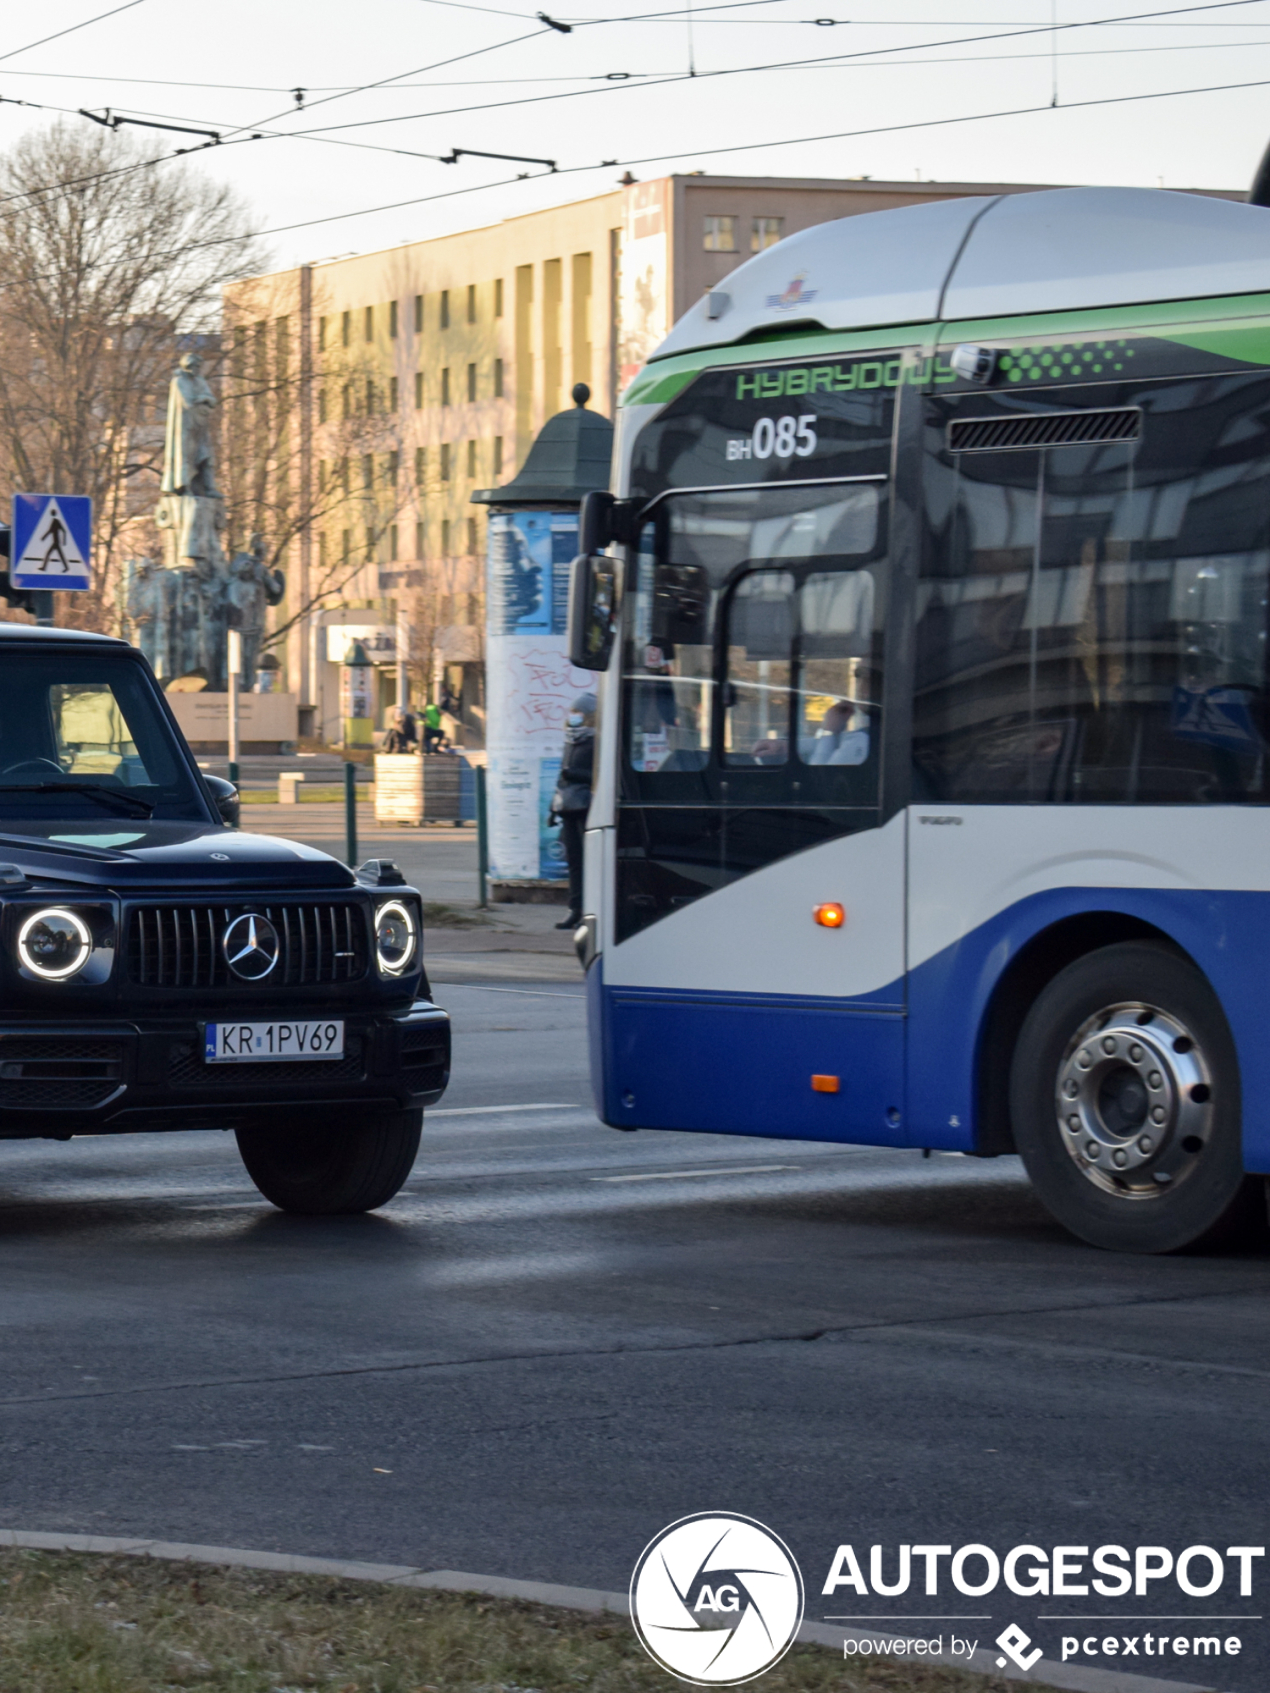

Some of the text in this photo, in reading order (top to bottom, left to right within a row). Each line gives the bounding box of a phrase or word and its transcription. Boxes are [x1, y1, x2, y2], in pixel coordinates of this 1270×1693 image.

[735, 357, 959, 401] HYBRYDOWY
[206, 1044, 215, 1052] PL
[222, 1023, 337, 1054] KR 1PV69
